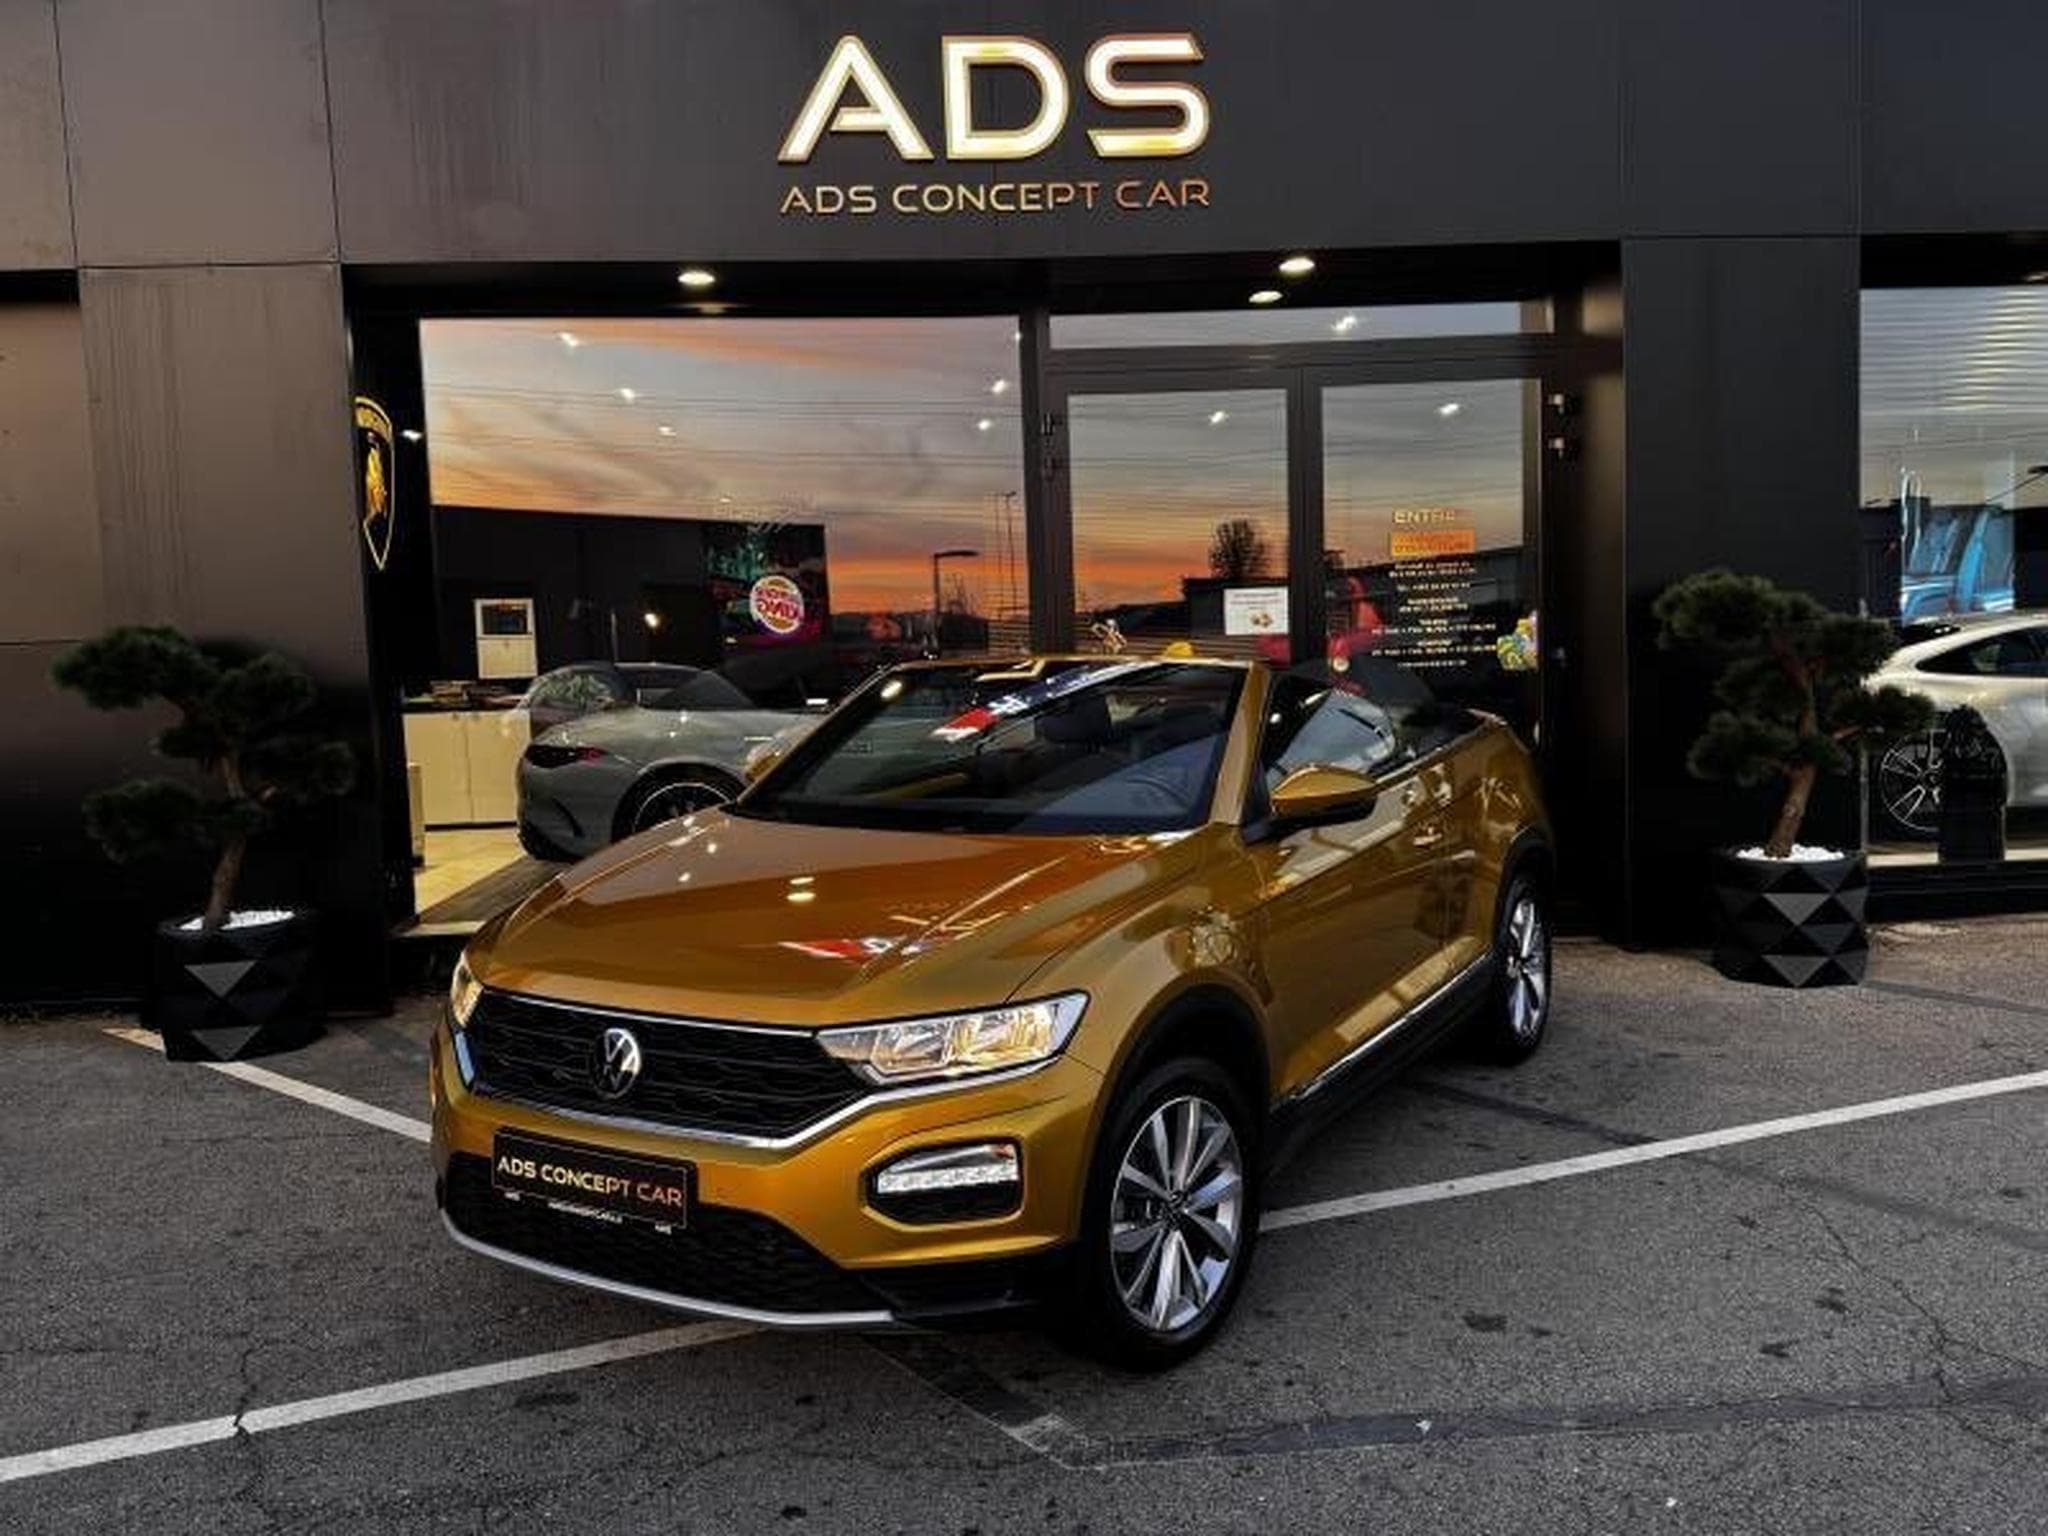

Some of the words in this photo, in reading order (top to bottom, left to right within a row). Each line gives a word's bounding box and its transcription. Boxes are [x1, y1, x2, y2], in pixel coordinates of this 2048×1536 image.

[777, 32, 1211, 161] ADS
[780, 185, 878, 214] ADS
[892, 182, 1099, 213] CONCEPT
[1115, 179, 1210, 209] CAR
[497, 1156, 537, 1179] ADS
[540, 1164, 631, 1197] CONCEPT
[636, 1183, 683, 1207] CAR
